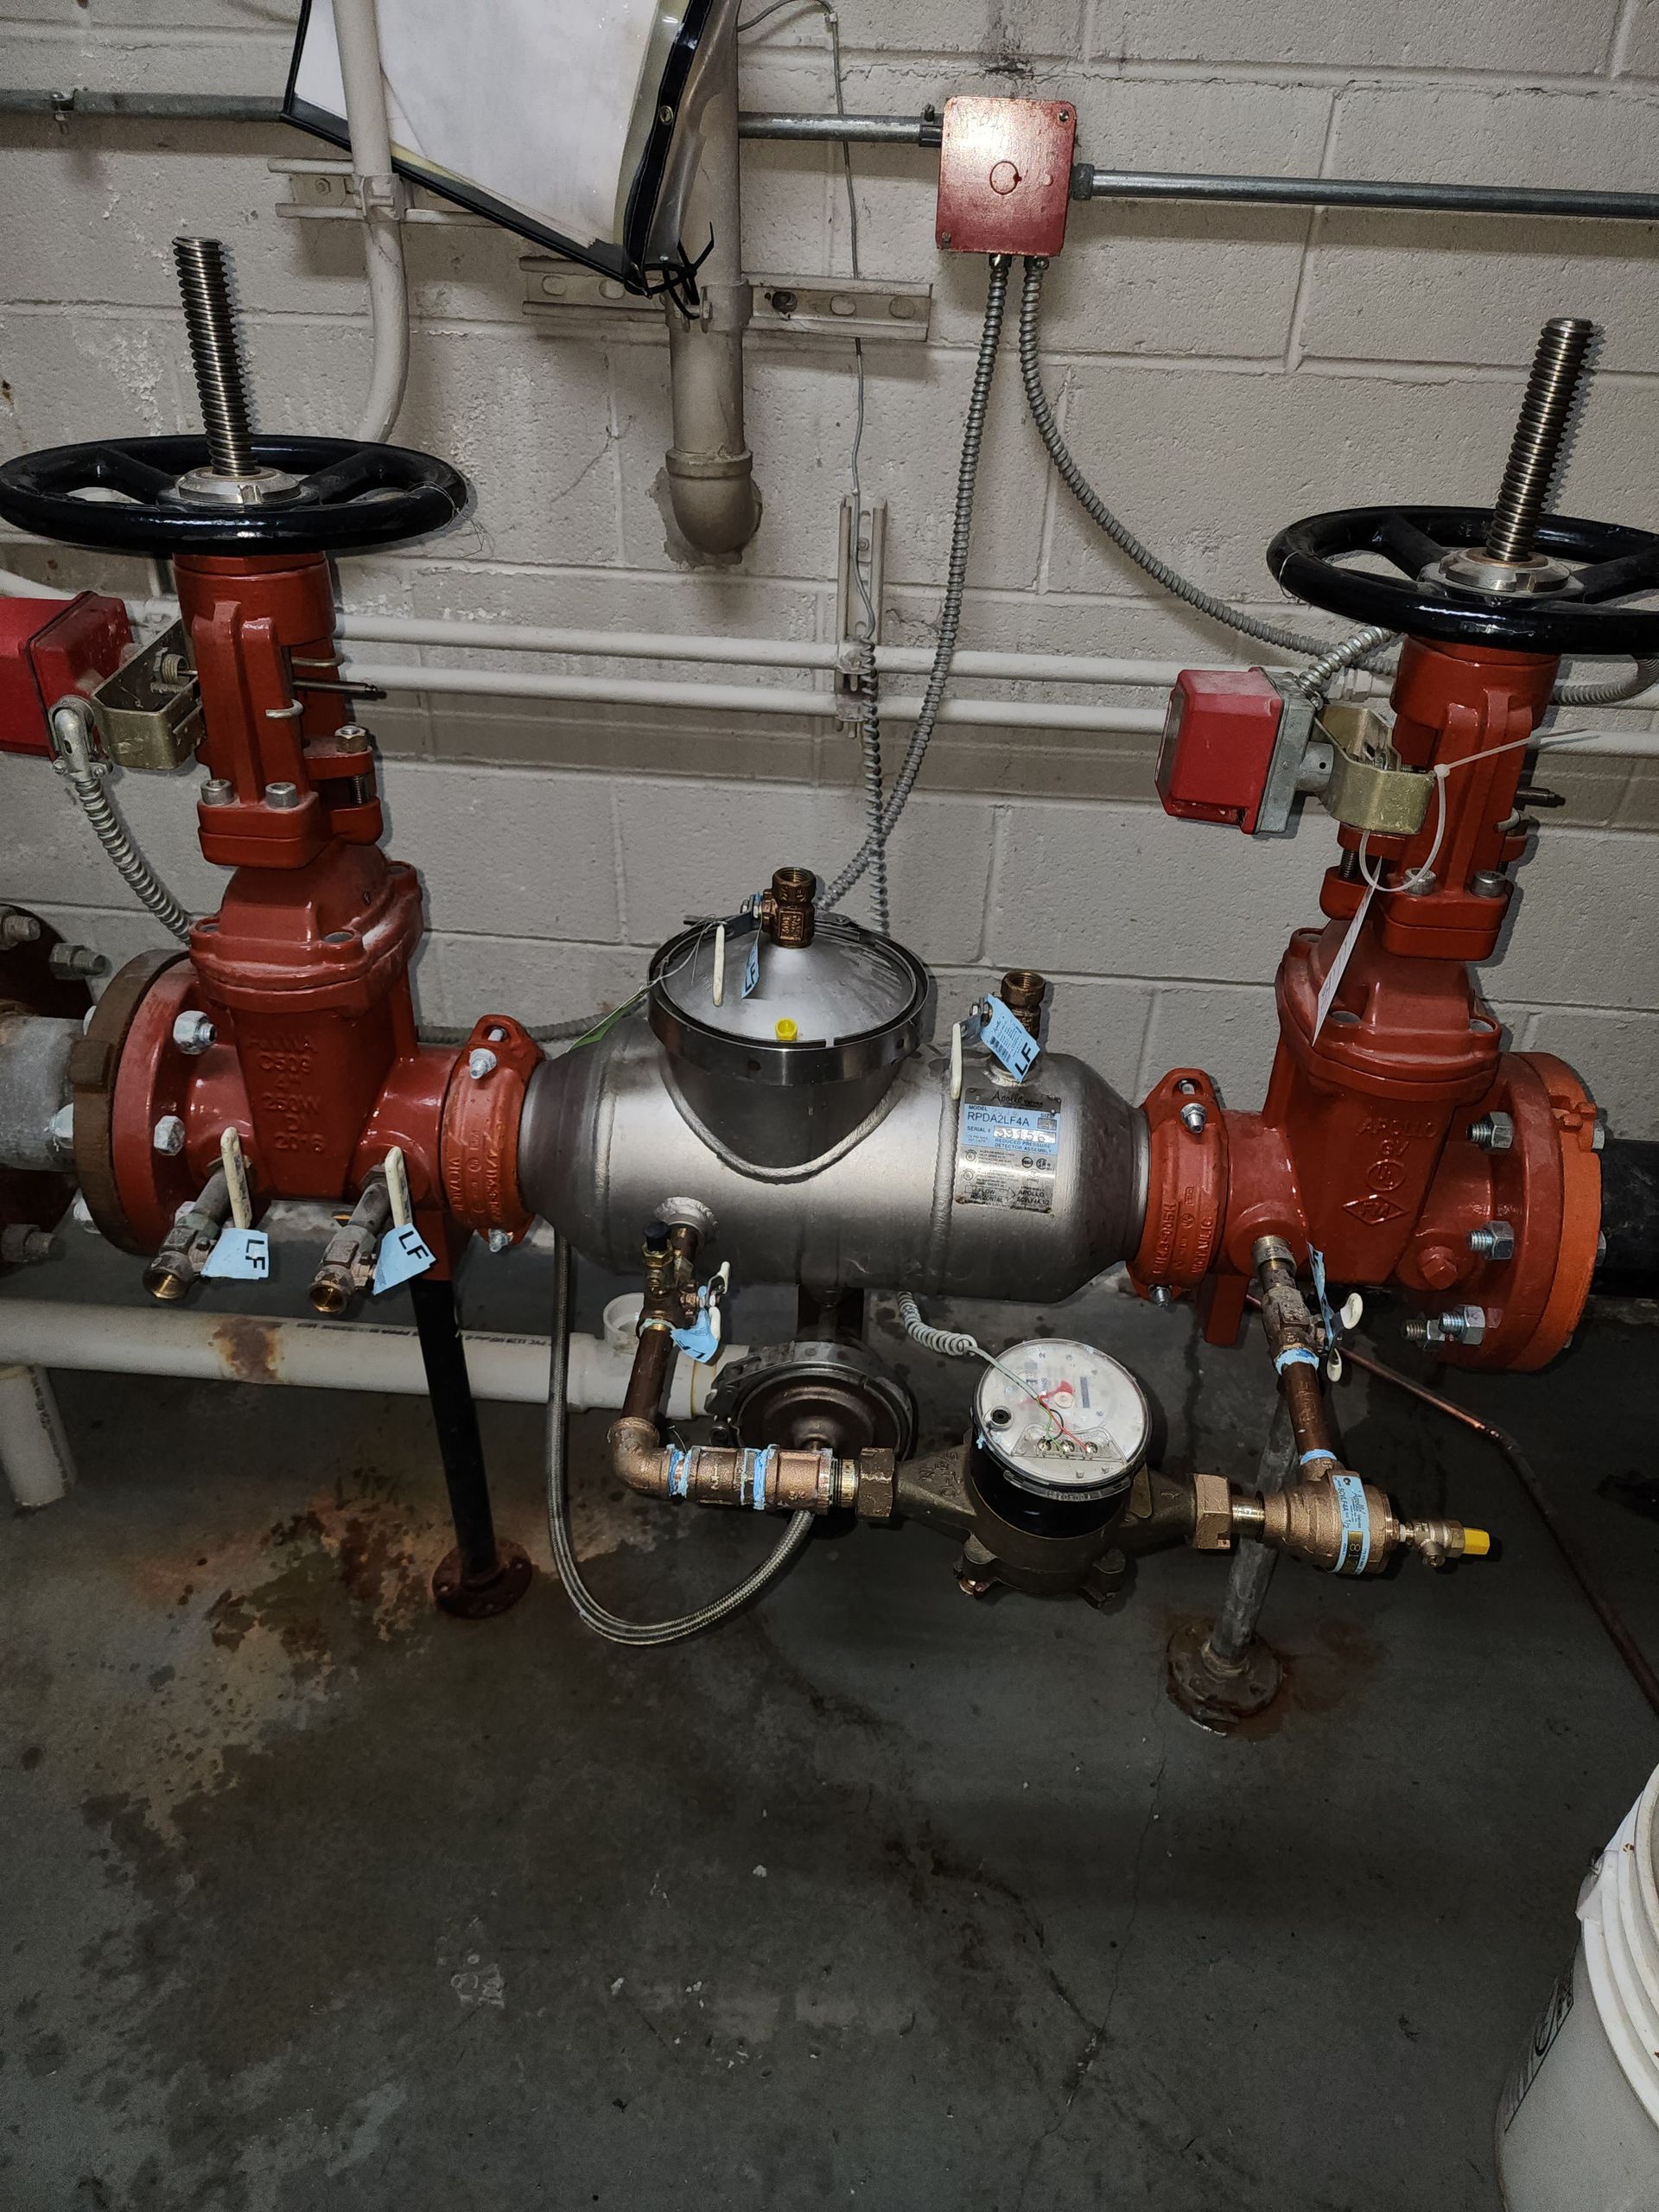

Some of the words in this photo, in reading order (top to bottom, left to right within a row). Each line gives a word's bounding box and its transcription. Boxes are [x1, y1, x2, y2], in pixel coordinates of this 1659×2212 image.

[744, 963, 756, 993] LF
[258, 1051, 311, 1072] C509
[1014, 1042, 1032, 1077] LF
[990, 1090, 1024, 1105] Apollo
[967, 1111, 1030, 1127] RPDA2LF4A
[1355, 1117, 1437, 1138] APOLLO
[245, 1238, 265, 1271] LF
[397, 1230, 430, 1260] LF
